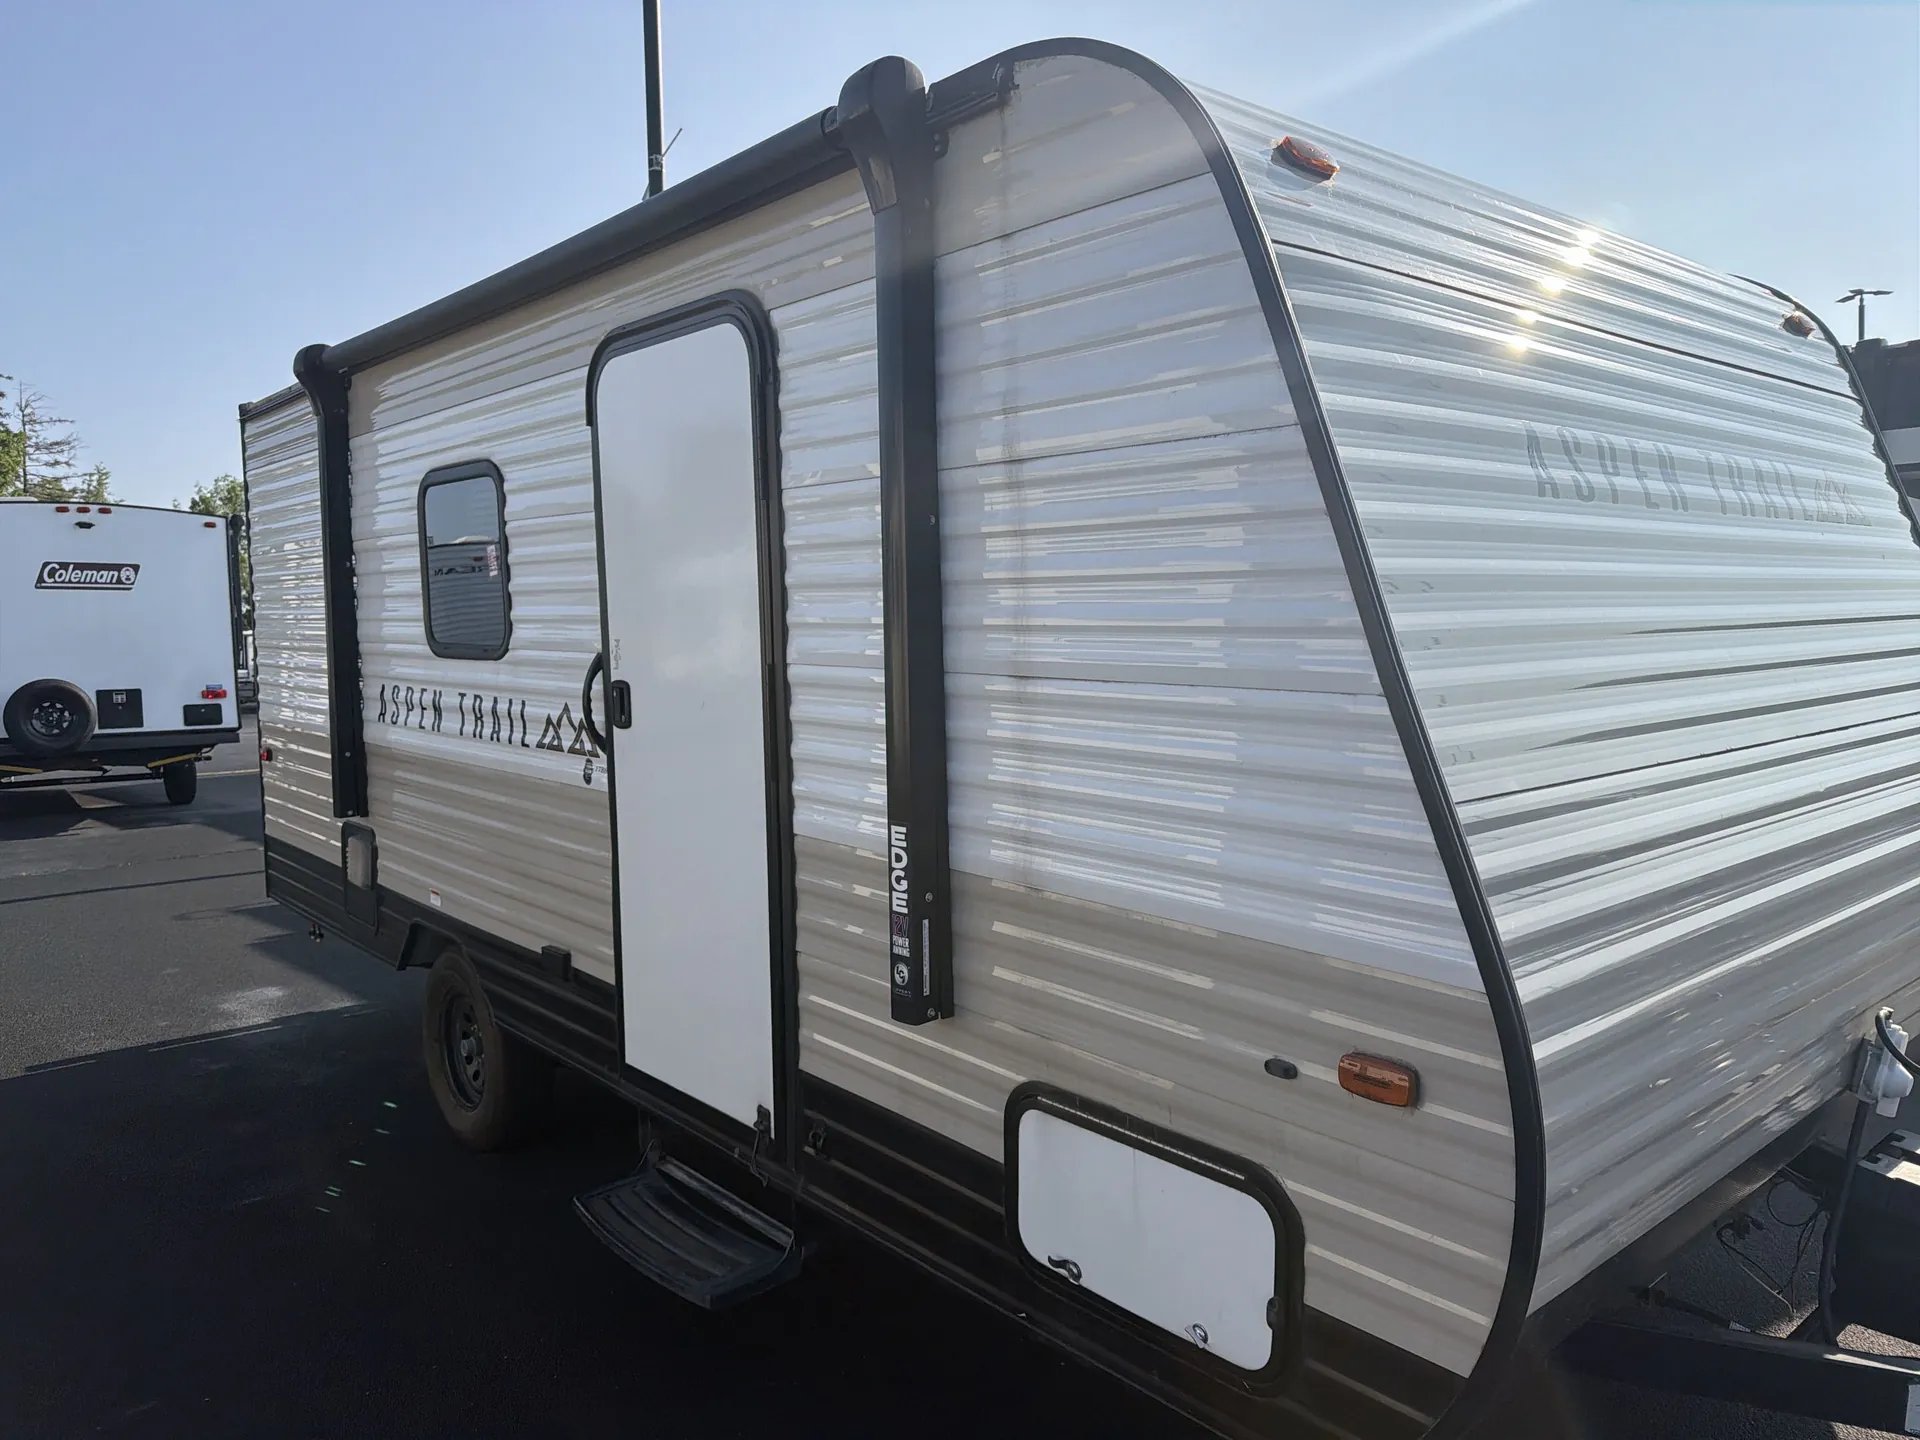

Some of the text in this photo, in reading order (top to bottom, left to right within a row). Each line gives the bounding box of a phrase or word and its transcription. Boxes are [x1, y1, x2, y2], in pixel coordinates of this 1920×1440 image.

[1521, 420, 1814, 522] ASPEN TRAIL
[43, 563, 119, 583] Coleman
[377, 684, 530, 748] ASPEN TRAIL
[891, 825, 908, 914] EDGE
[892, 934, 910, 948] POWER
